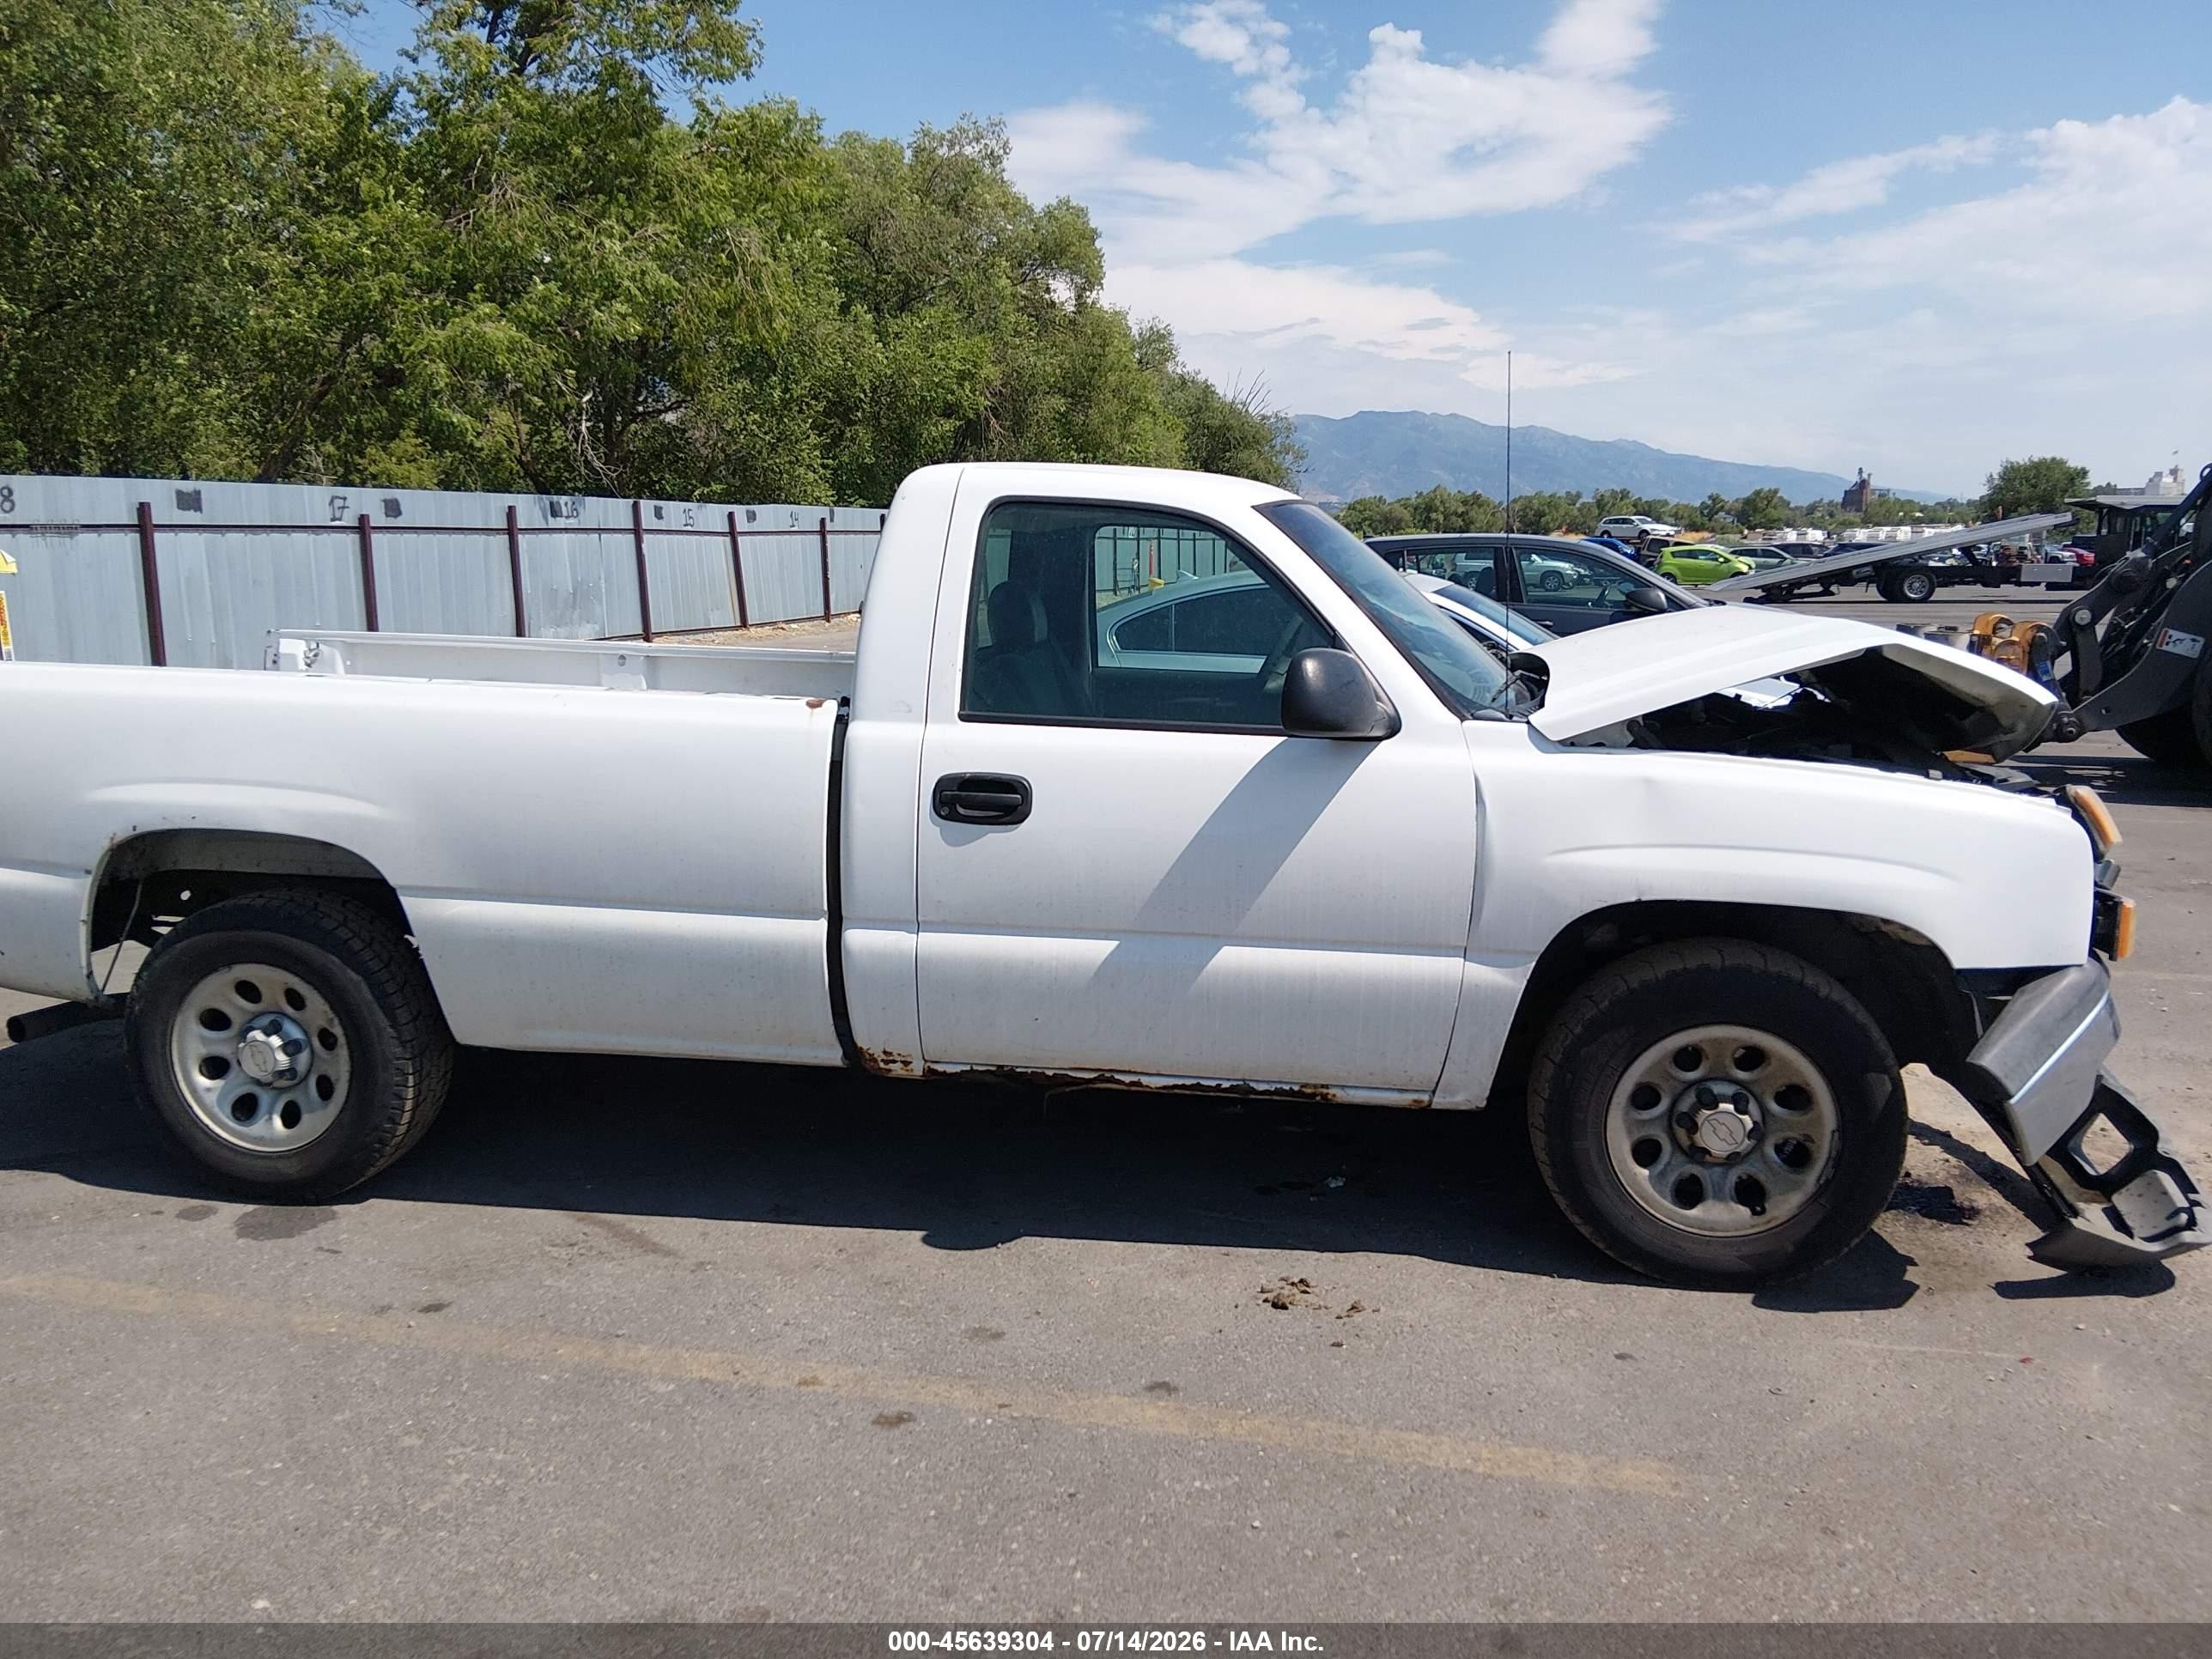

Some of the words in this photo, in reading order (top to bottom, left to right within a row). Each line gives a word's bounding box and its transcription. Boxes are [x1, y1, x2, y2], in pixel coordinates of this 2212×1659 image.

[564, 501, 579, 520] 16
[683, 508, 695, 527] 15
[789, 508, 799, 529] 14
